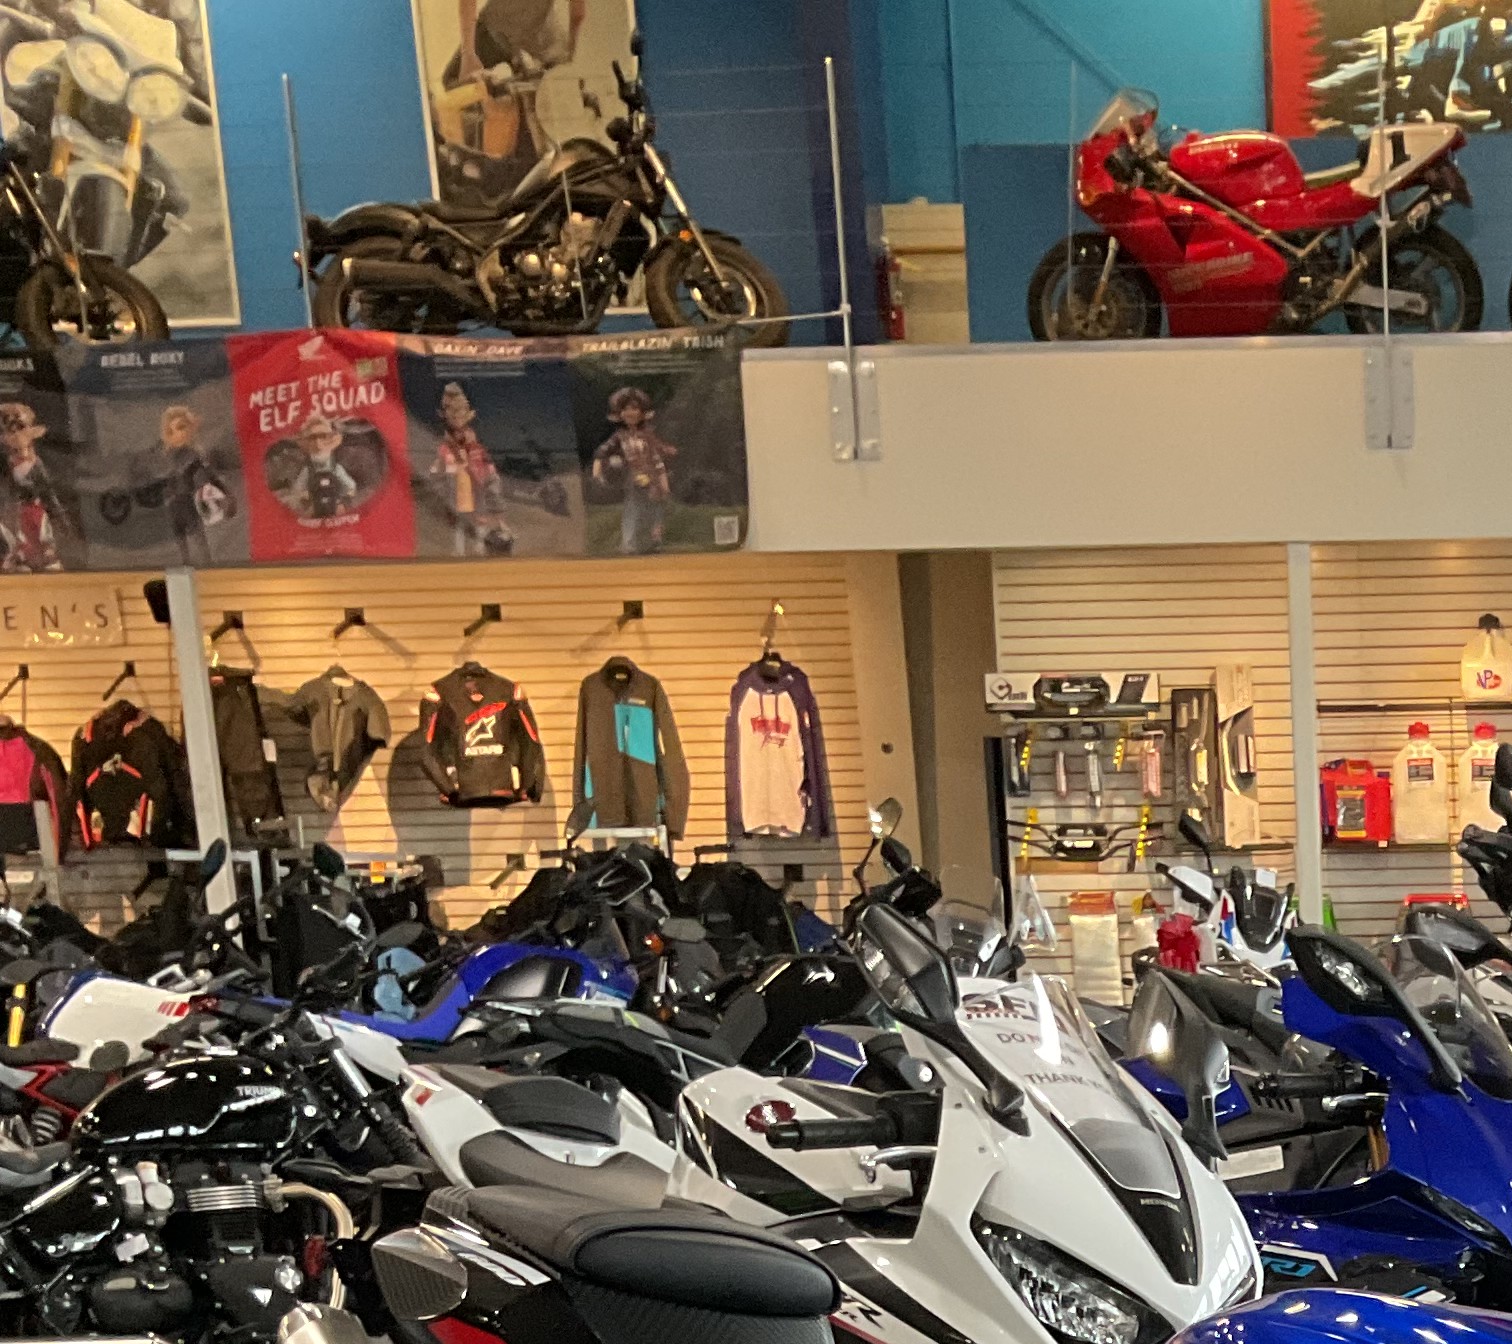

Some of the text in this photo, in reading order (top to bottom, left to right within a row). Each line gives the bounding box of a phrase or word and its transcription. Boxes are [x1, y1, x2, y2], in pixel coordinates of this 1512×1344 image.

[249, 370, 343, 409] MEET THE
[259, 381, 386, 433] ELF SQUAD
